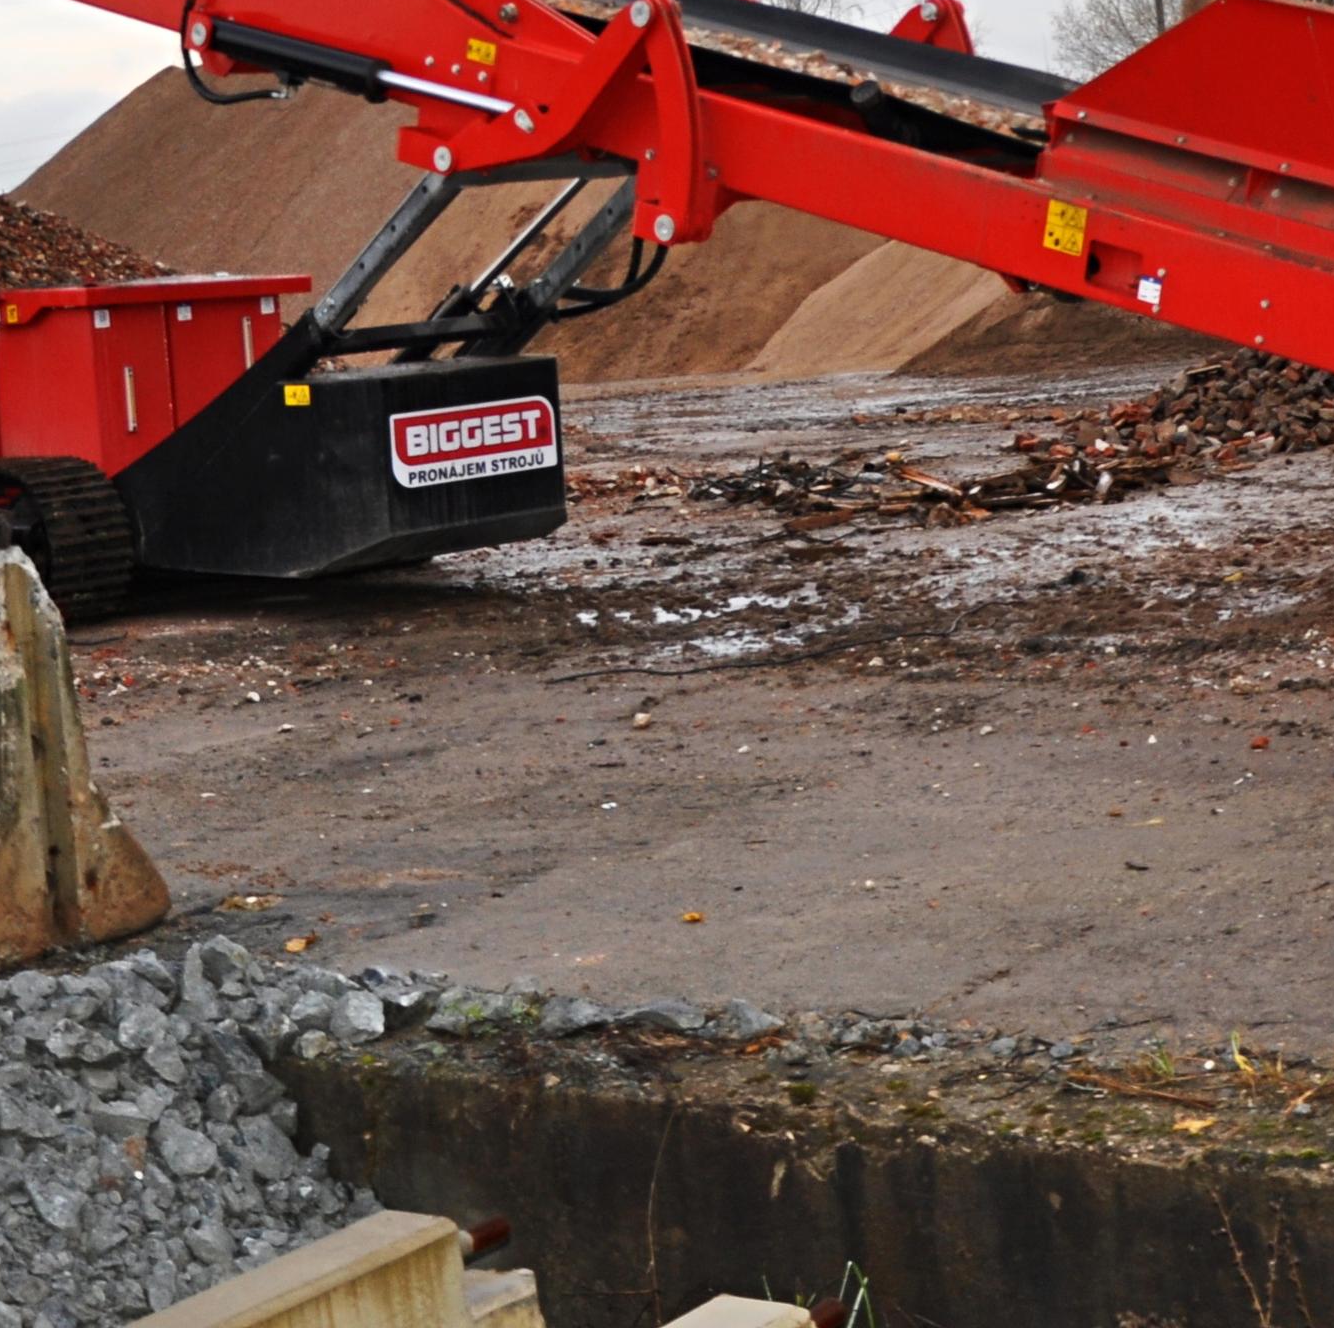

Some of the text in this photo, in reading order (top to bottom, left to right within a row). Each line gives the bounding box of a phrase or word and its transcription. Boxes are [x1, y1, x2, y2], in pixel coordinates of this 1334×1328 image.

[405, 409, 541, 457] BIGGEST
[408, 448, 545, 484] PRONÁJEM STROJŮ
